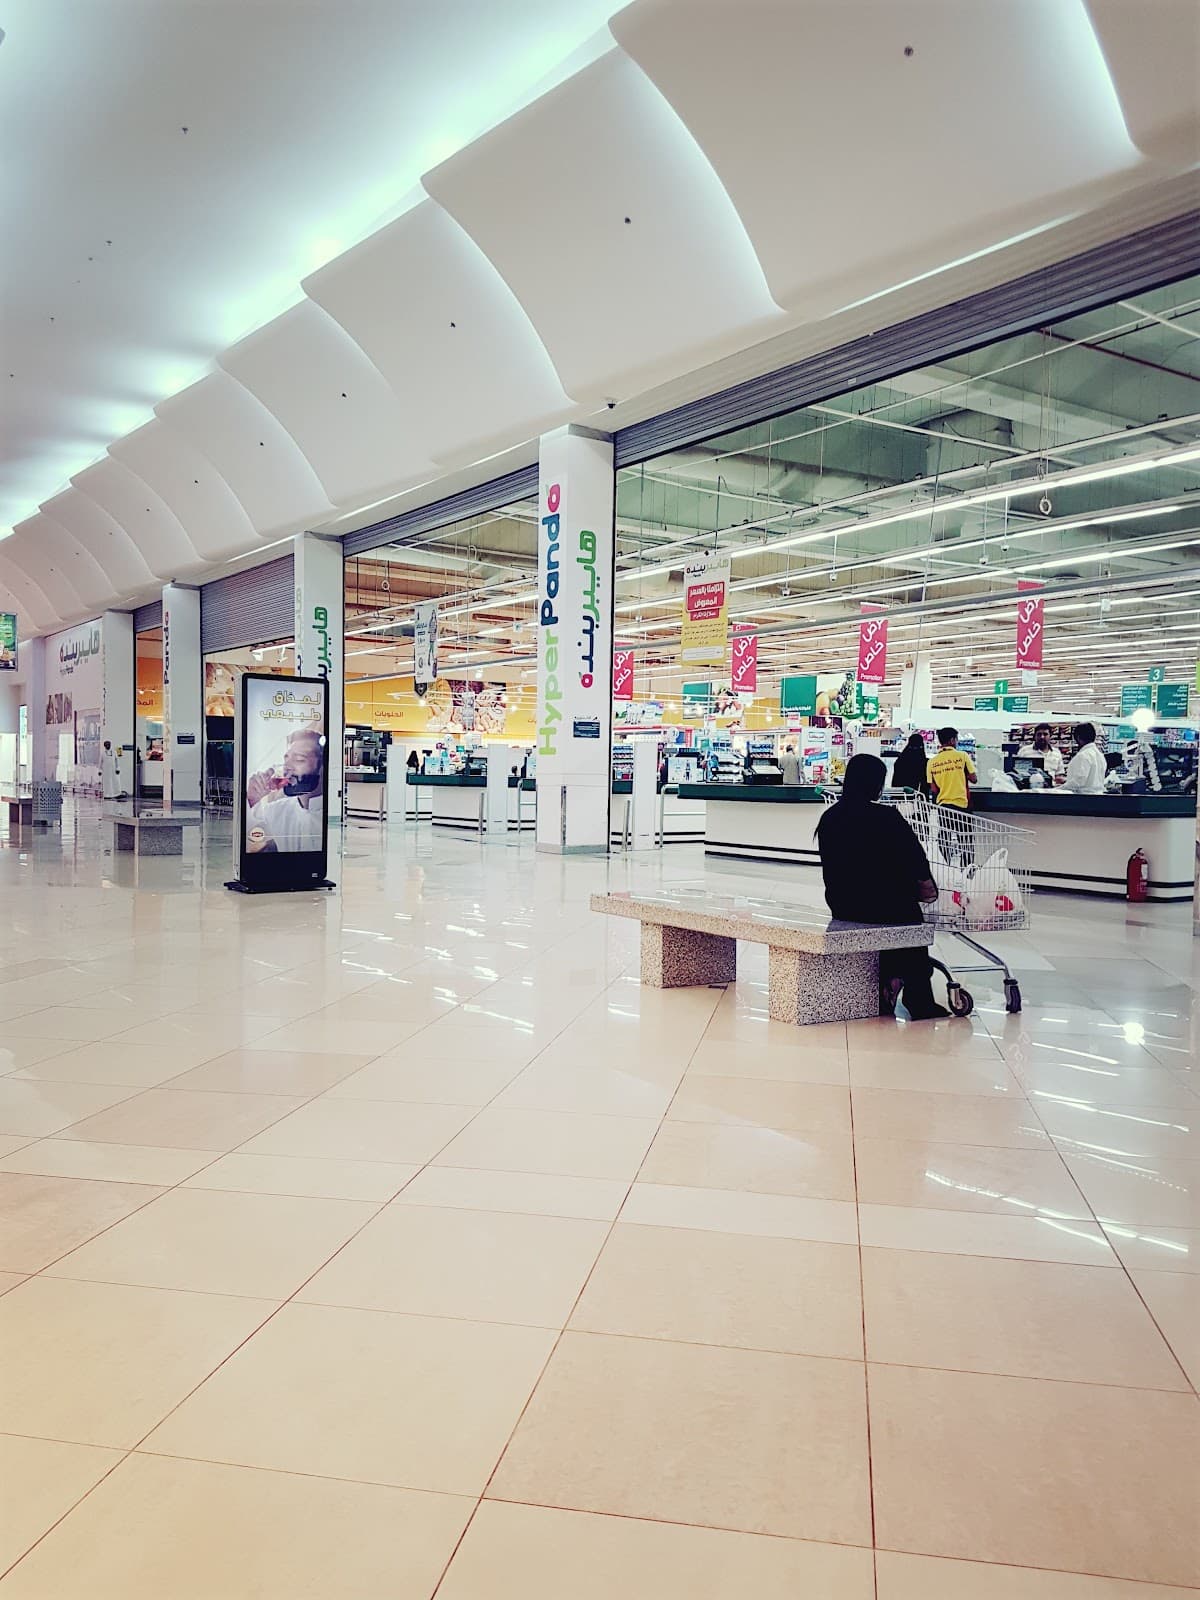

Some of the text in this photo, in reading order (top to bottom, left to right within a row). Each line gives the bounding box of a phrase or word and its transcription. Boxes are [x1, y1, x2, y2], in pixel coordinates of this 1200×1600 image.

[1018, 621, 1041, 656] خاص
[860, 640, 884, 670] خاص
[733, 655, 755, 682] خاص
[860, 673, 884, 681] Promotion
[1152, 669, 1160, 680] 3
[998, 682, 1004, 693] 1
